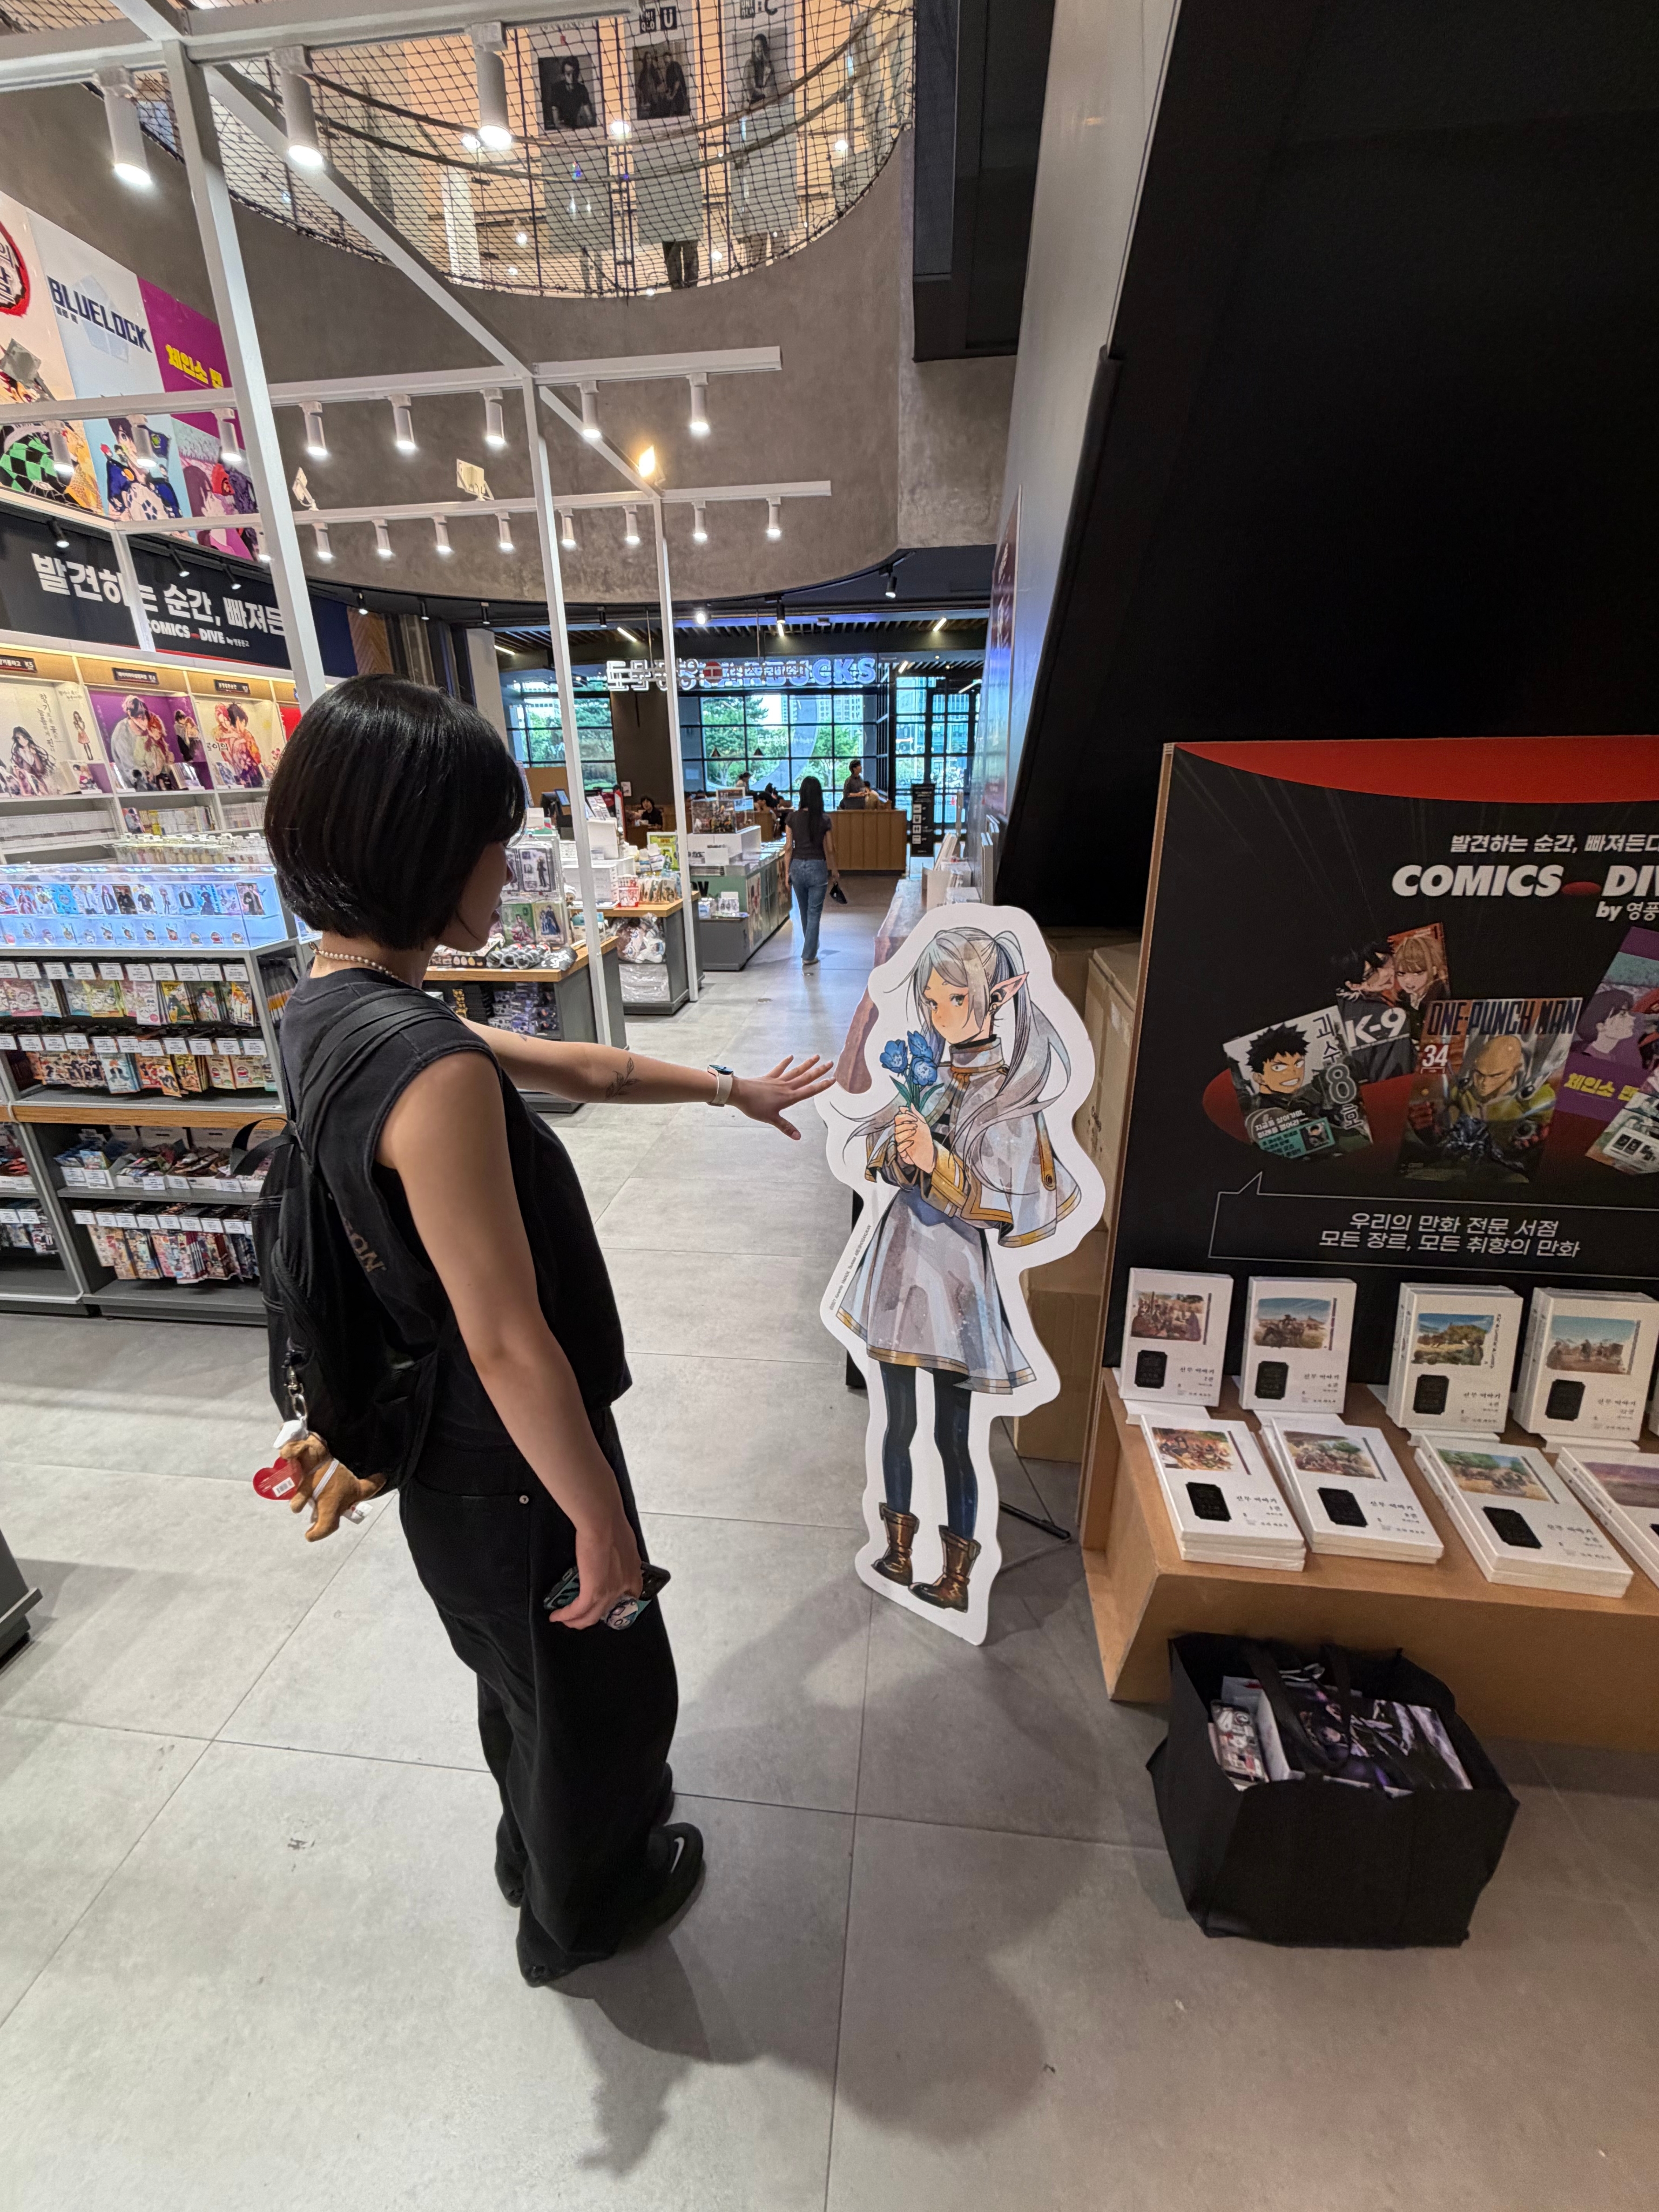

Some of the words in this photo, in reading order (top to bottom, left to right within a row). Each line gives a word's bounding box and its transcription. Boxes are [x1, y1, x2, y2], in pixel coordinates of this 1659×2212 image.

[46, 275, 153, 353] BLUELOCK
[164, 583, 221, 626] 순간,
[147, 619, 191, 639] OMICS
[199, 630, 225, 645] DIVE
[679, 656, 876, 689] ARBUCKS
[1451, 834, 1528, 853] 발견하는
[1533, 834, 1577, 854] 순간,
[1391, 865, 1564, 896] COMICS
[1602, 865, 1659, 896] DI
[1596, 901, 1622, 921] by
[1345, 1007, 1406, 1048] K-9
[1422, 1044, 1447, 1069] 34
[1563, 1073, 1615, 1097] 체인소
[1350, 1212, 1412, 1231] 우리의
[1419, 1215, 1461, 1233] 만화
[1466, 1217, 1509, 1236] 전문
[1514, 1219, 1559, 1238] 서점
[1319, 1230, 1361, 1247] 모든
[1366, 1232, 1411, 1252] 장르,
[1418, 1235, 1461, 1253] 모든
[1466, 1236, 1530, 1256] 취향의
[1535, 1239, 1580, 1258] 만화
